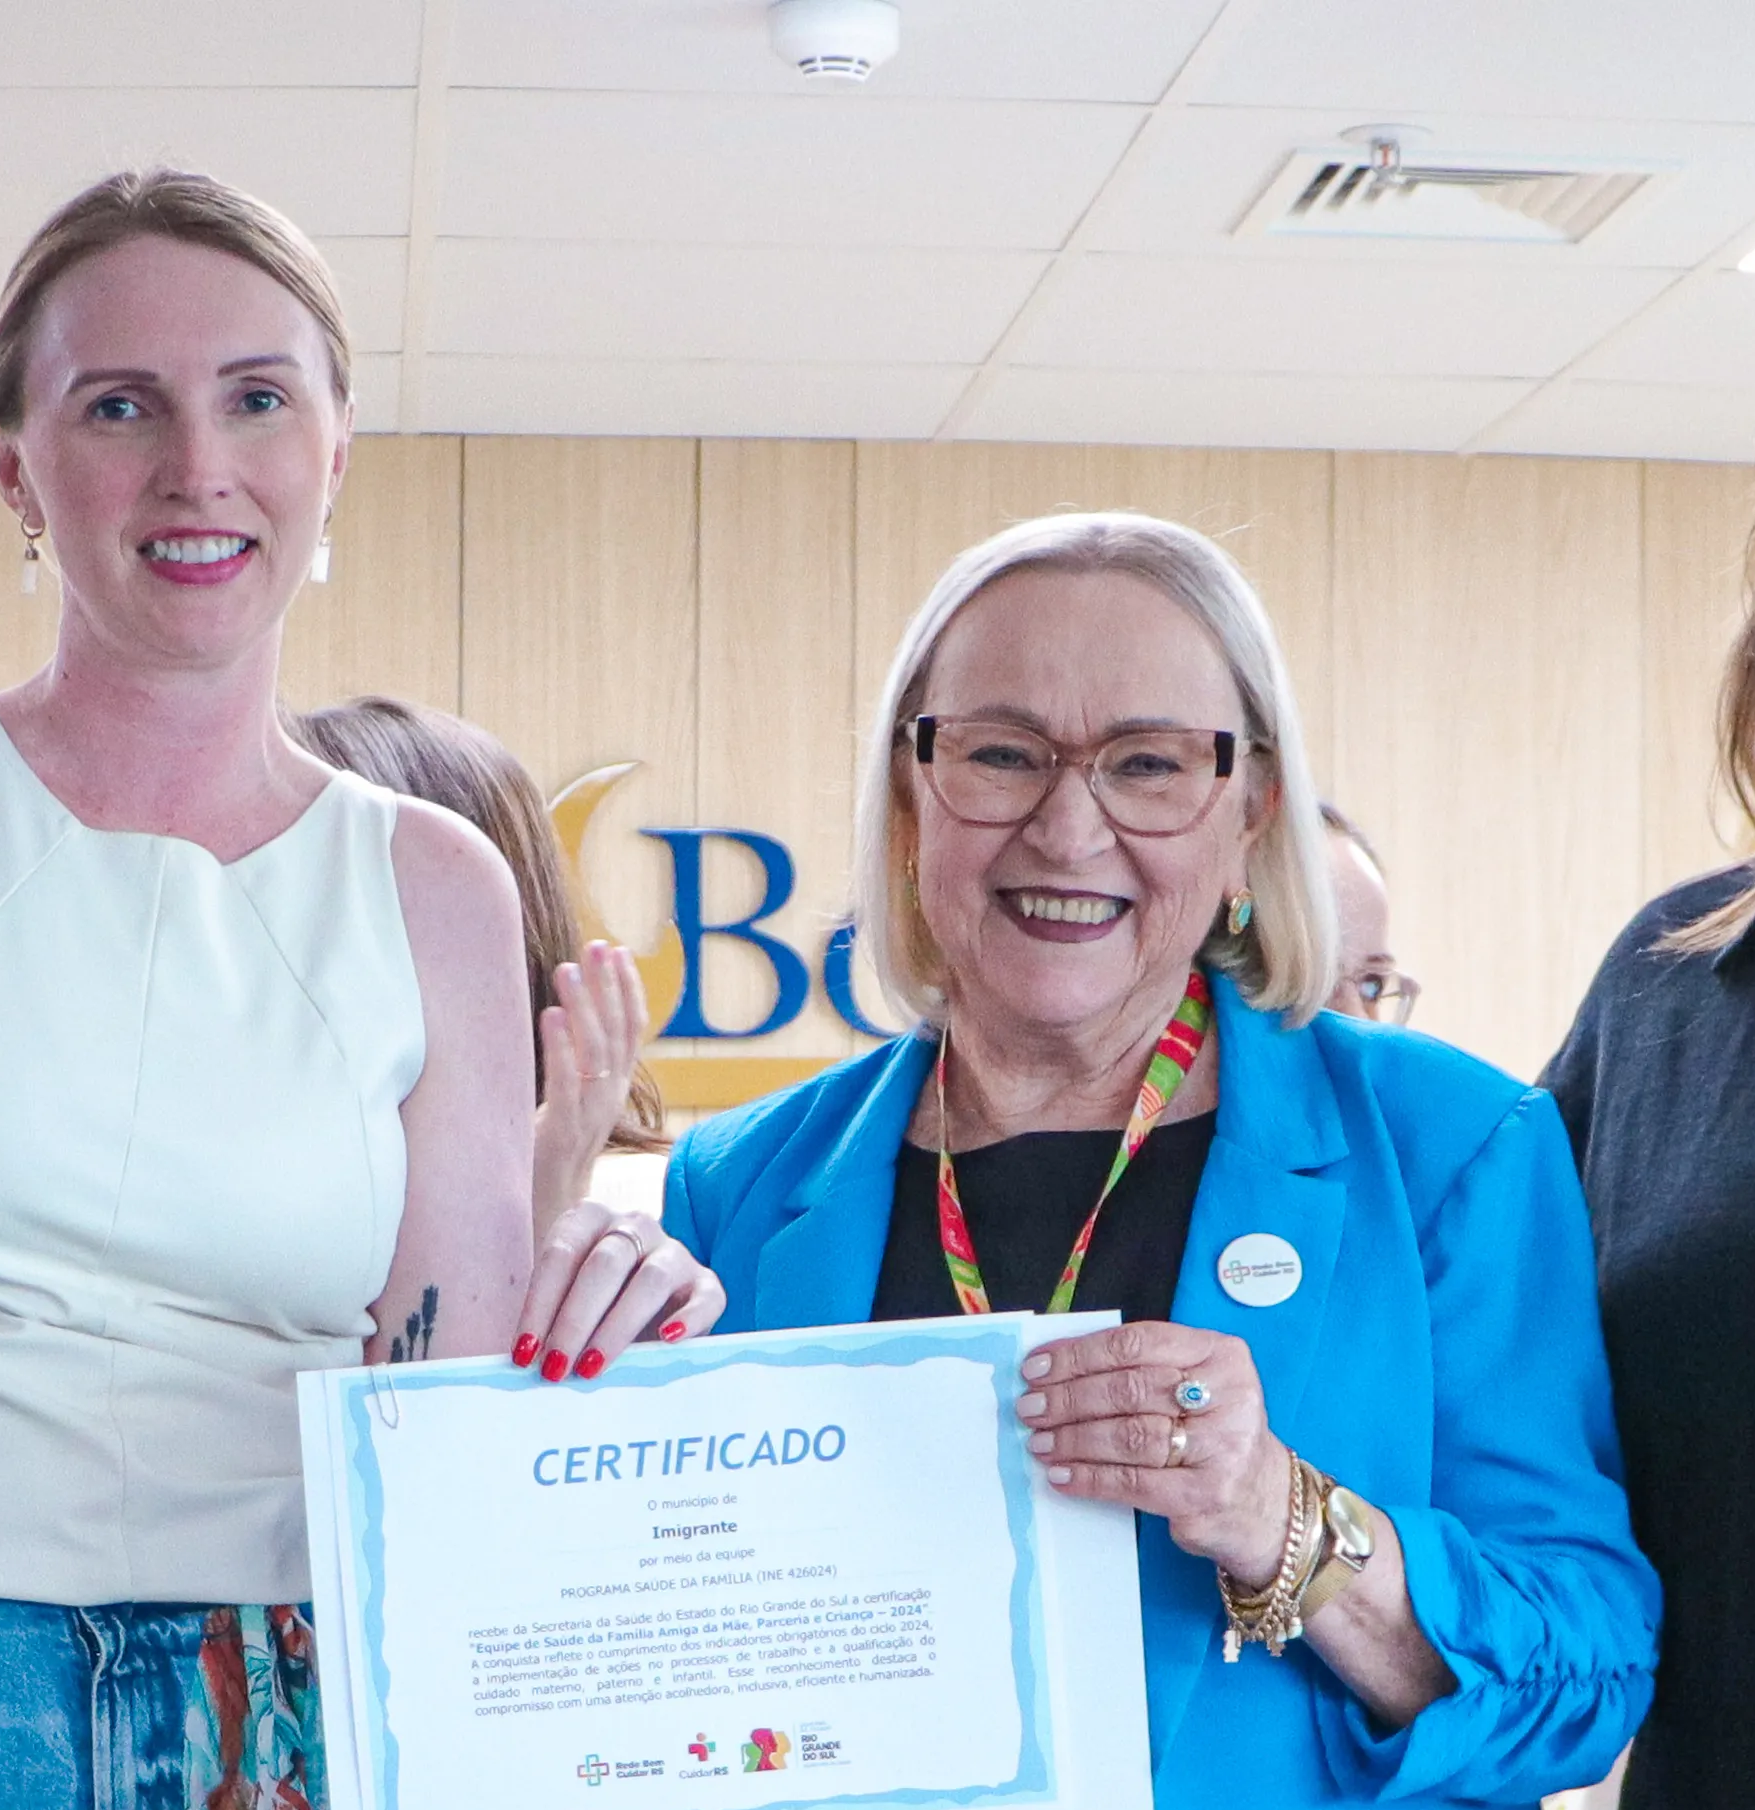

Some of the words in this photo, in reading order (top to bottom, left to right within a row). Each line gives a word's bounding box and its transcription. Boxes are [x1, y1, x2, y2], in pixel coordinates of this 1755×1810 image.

[533, 1424, 846, 1486] CERTIFICADO
[647, 1499, 657, 1511] O
[661, 1495, 719, 1509] município
[722, 1492, 737, 1505] de
[652, 1521, 737, 1540] Imigrante
[639, 1556, 659, 1569] por
[663, 1553, 692, 1564] meio
[696, 1550, 712, 1562] da
[715, 1548, 756, 1561] equipe
[560, 1583, 631, 1599] PROGRAMA
[634, 1578, 676, 1593] SAÚDE
[680, 1577, 698, 1589] DA
[701, 1572, 753, 1586] FAMÍLIA
[787, 1564, 837, 1579] 426024)
[468, 1626, 509, 1638] recebe
[513, 1624, 528, 1635] da
[531, 1619, 592, 1634] Secretaria
[596, 1616, 611, 1628] da
[615, 1612, 652, 1626] Saúde
[656, 1610, 672, 1623] do
[675, 1607, 716, 1621] Estado
[720, 1605, 735, 1616] do
[739, 1603, 759, 1614] Rio
[762, 1599, 806, 1613] Grande
[810, 1597, 826, 1609] do
[829, 1594, 848, 1607] Sul
[852, 1595, 859, 1605] a
[863, 1587, 931, 1604] certificação
[523, 1638, 540, 1650] de
[543, 1634, 584, 1648] Saúde
[587, 1632, 604, 1644] da
[607, 1628, 654, 1642] Família
[658, 1626, 699, 1638] Amiga
[702, 1623, 718, 1633] da
[756, 1615, 810, 1629] Parceria
[813, 1615, 822, 1624] e
[825, 1610, 874, 1622] Criança
[471, 1659, 480, 1669] A
[482, 1655, 540, 1669] conquista
[544, 1650, 583, 1663] reflete
[586, 1650, 594, 1660] o
[598, 1643, 677, 1659] cumprimento
[680, 1640, 702, 1651] dos
[705, 1633, 772, 1648] indicadores
[776, 1628, 847, 1643] obrigatórios
[850, 1625, 867, 1636] do
[869, 1622, 896, 1634] ciclo
[900, 1619, 933, 1632] 2024,
[472, 1676, 480, 1685] a
[487, 1665, 578, 1685] implementação
[584, 1664, 600, 1676] de
[606, 1660, 641, 1675] ações
[648, 1660, 663, 1670] no
[670, 1654, 729, 1670] processos
[735, 1650, 751, 1662] de
[757, 1645, 807, 1660] trabalho
[813, 1646, 821, 1655] e
[828, 1644, 836, 1654] a
[843, 1635, 913, 1654] qualificação
[919, 1634, 936, 1646] do
[473, 1686, 520, 1701] cuidado
[531, 1683, 585, 1696] materno,
[596, 1678, 643, 1691] paterno
[653, 1675, 661, 1685] e
[672, 1669, 716, 1683] infantil.
[727, 1667, 755, 1678] Esse
[765, 1657, 861, 1674] reconhecimento
[871, 1653, 917, 1666] destaca
[928, 1651, 936, 1661] o
[474, 1701, 554, 1716] compromisso
[557, 1698, 582, 1709] com
[585, 1696, 612, 1707] uma
[614, 1689, 662, 1704] atenção
[665, 1684, 734, 1699] acolhedora,
[737, 1679, 791, 1692] inclusiva,
[795, 1674, 846, 1687] eficiente
[848, 1673, 856, 1683] e
[859, 1666, 934, 1681] humanizada.
[801, 1734, 818, 1743] RIO
[801, 1741, 840, 1753] GRANDE
[802, 1752, 817, 1761] DO
